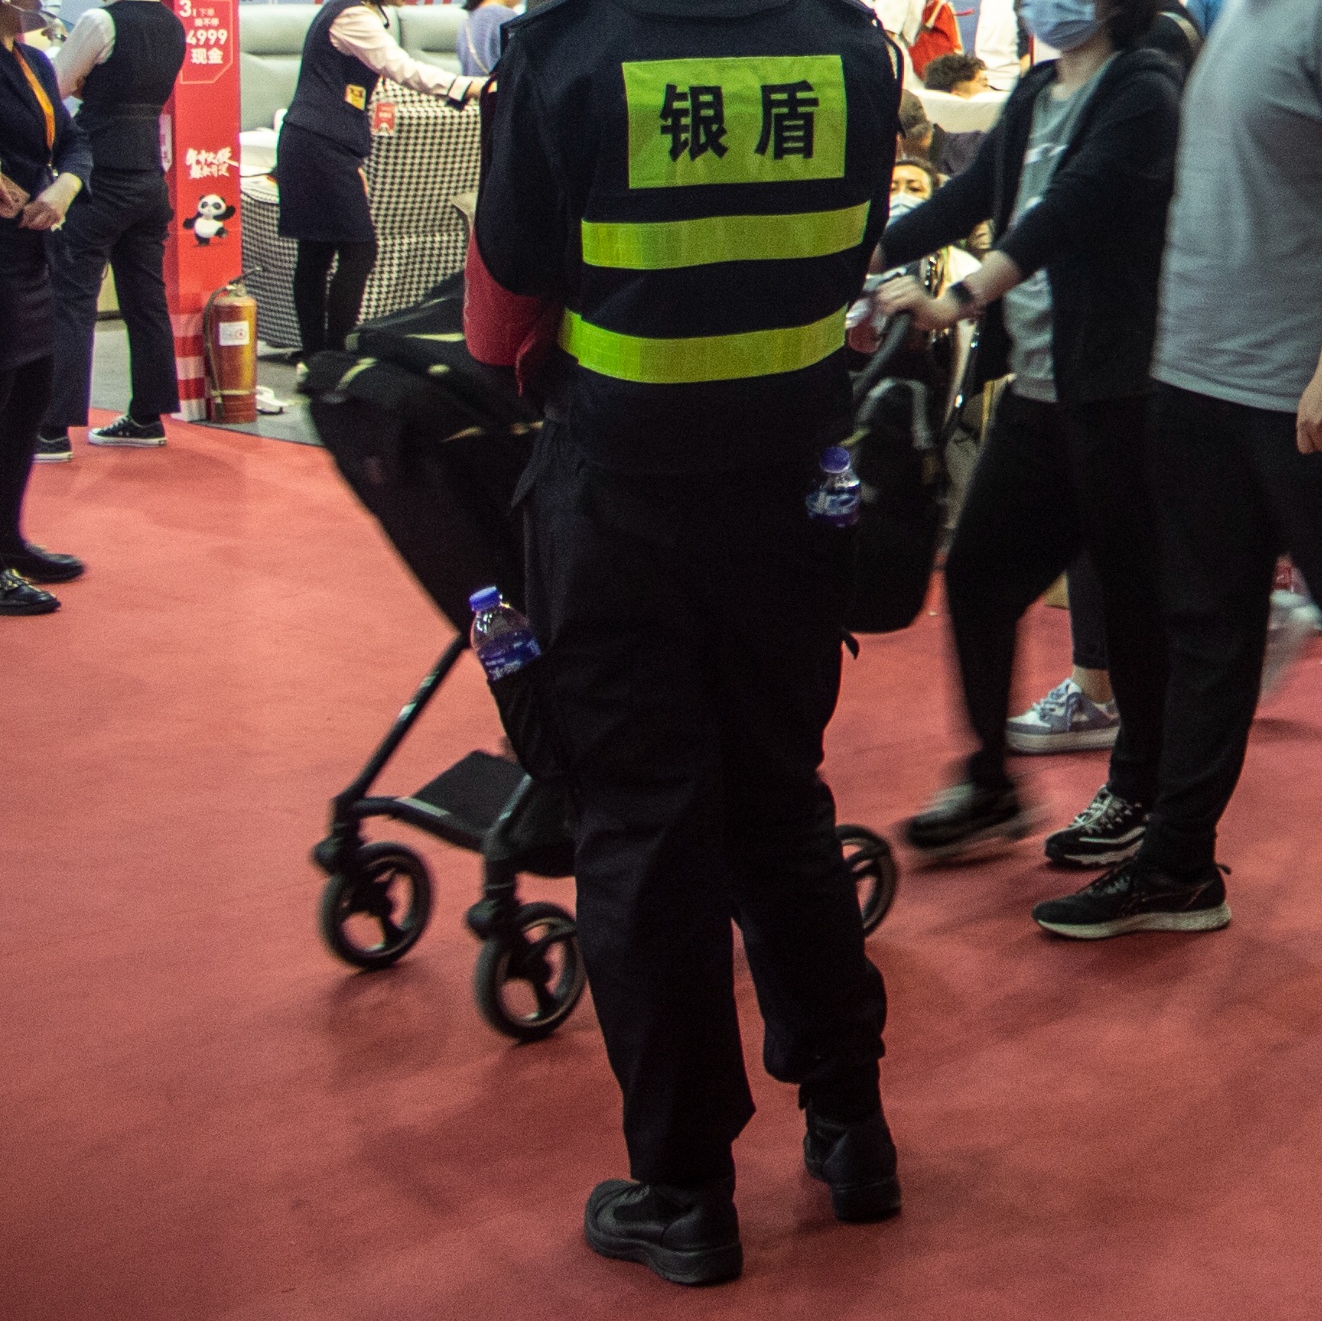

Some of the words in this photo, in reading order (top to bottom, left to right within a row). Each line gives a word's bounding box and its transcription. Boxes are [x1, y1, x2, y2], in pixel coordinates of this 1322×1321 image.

[179, 0, 192, 18] 3
[185, 30, 228, 46] 4999
[190, 48, 223, 65] 现金
[660, 80, 819, 162] 银盾
